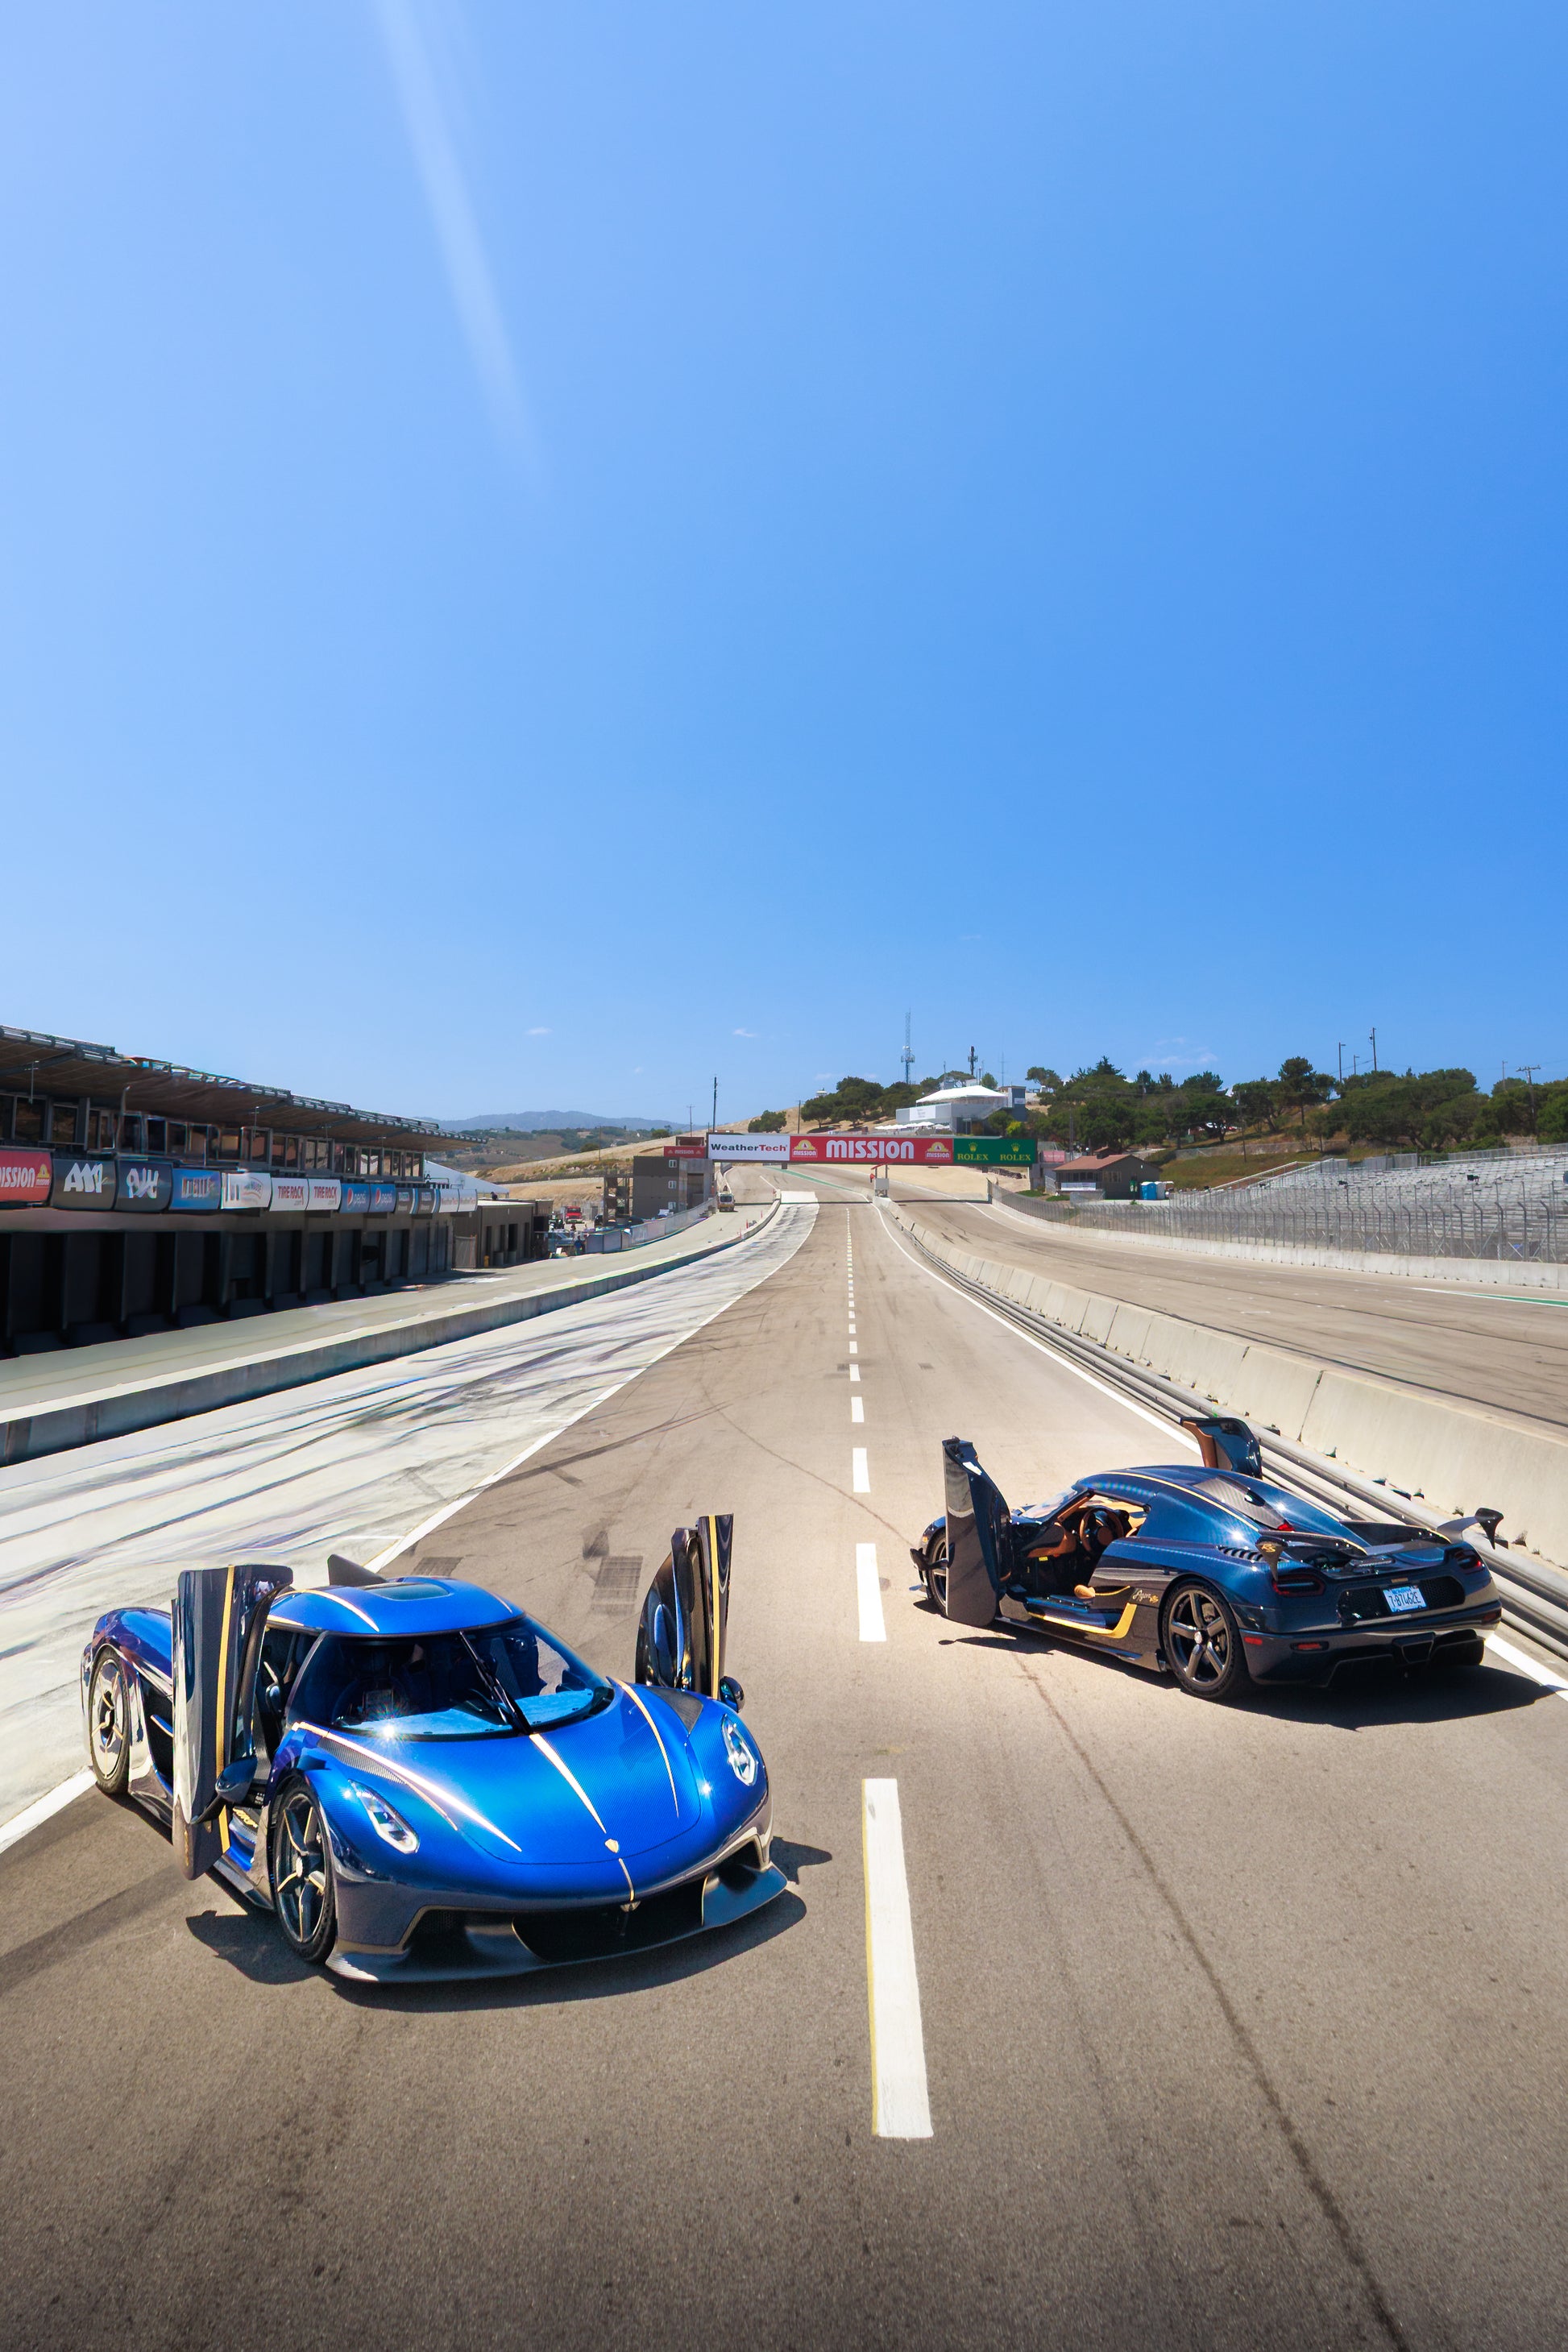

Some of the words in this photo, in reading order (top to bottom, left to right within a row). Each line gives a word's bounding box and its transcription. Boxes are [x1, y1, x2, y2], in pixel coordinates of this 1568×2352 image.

[711, 1143, 787, 1151] WeatherTech
[826, 1140, 915, 1159] MISSION
[0, 1167, 35, 1188] ISSION
[278, 1186, 290, 1199] TIRE
[313, 1186, 325, 1199] TIRE
[353, 1189, 367, 1207] pepsi
[381, 1189, 393, 1207] pepsi
[1261, 1543, 1276, 1553] RS
